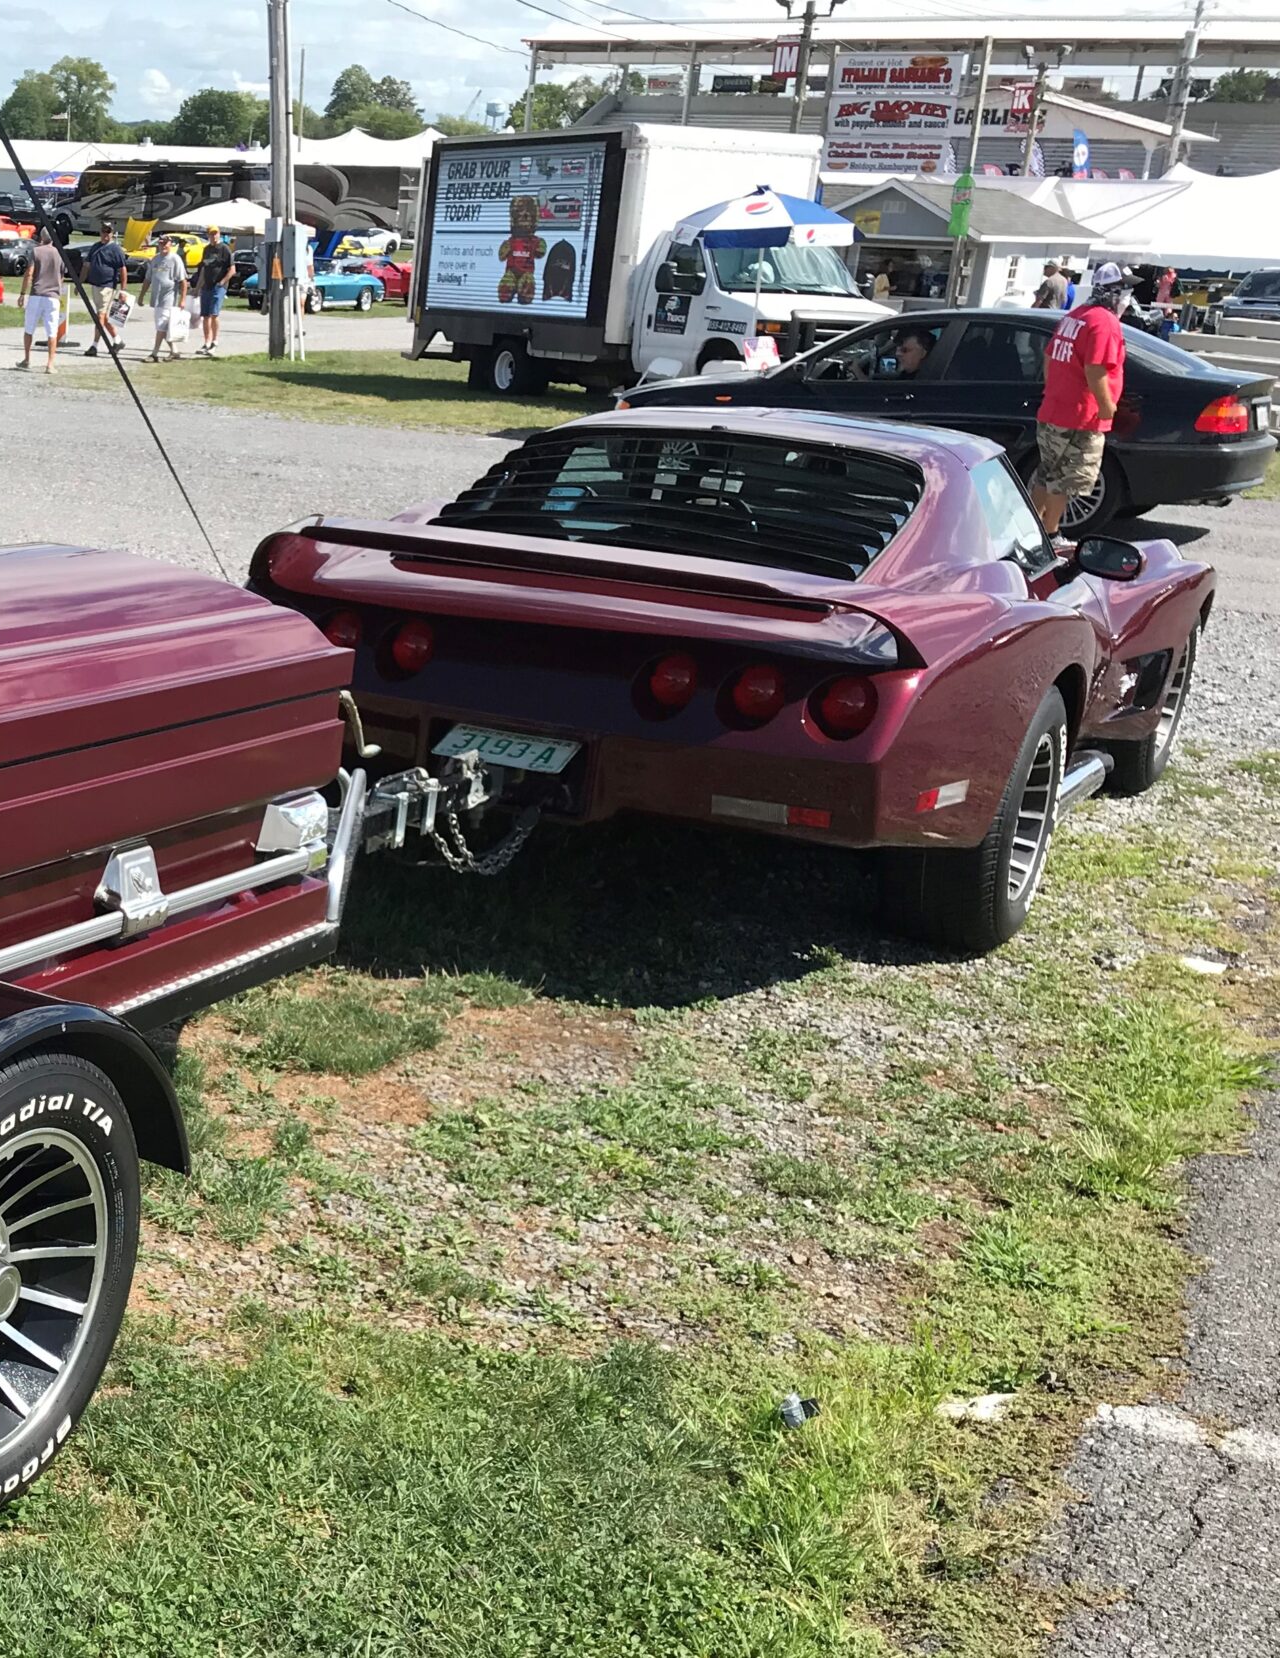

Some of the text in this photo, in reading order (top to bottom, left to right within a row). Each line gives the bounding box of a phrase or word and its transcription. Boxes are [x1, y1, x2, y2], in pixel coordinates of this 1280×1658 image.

[774, 46, 799, 73] IM
[887, 58, 903, 66] Hot
[841, 67, 887, 83] ITALIAN
[836, 101, 871, 118] BIG
[834, 119, 849, 127] with
[908, 119, 922, 128] and
[924, 119, 949, 128] sauce!
[447, 160, 511, 180] GRAB YOUR
[445, 181, 512, 200] EVENT GEAR
[461, 245, 474, 257] and
[475, 245, 494, 257] much
[438, 260, 476, 270] more over in
[437, 273, 462, 287] Building
[82, 1097, 114, 1137] T/A
